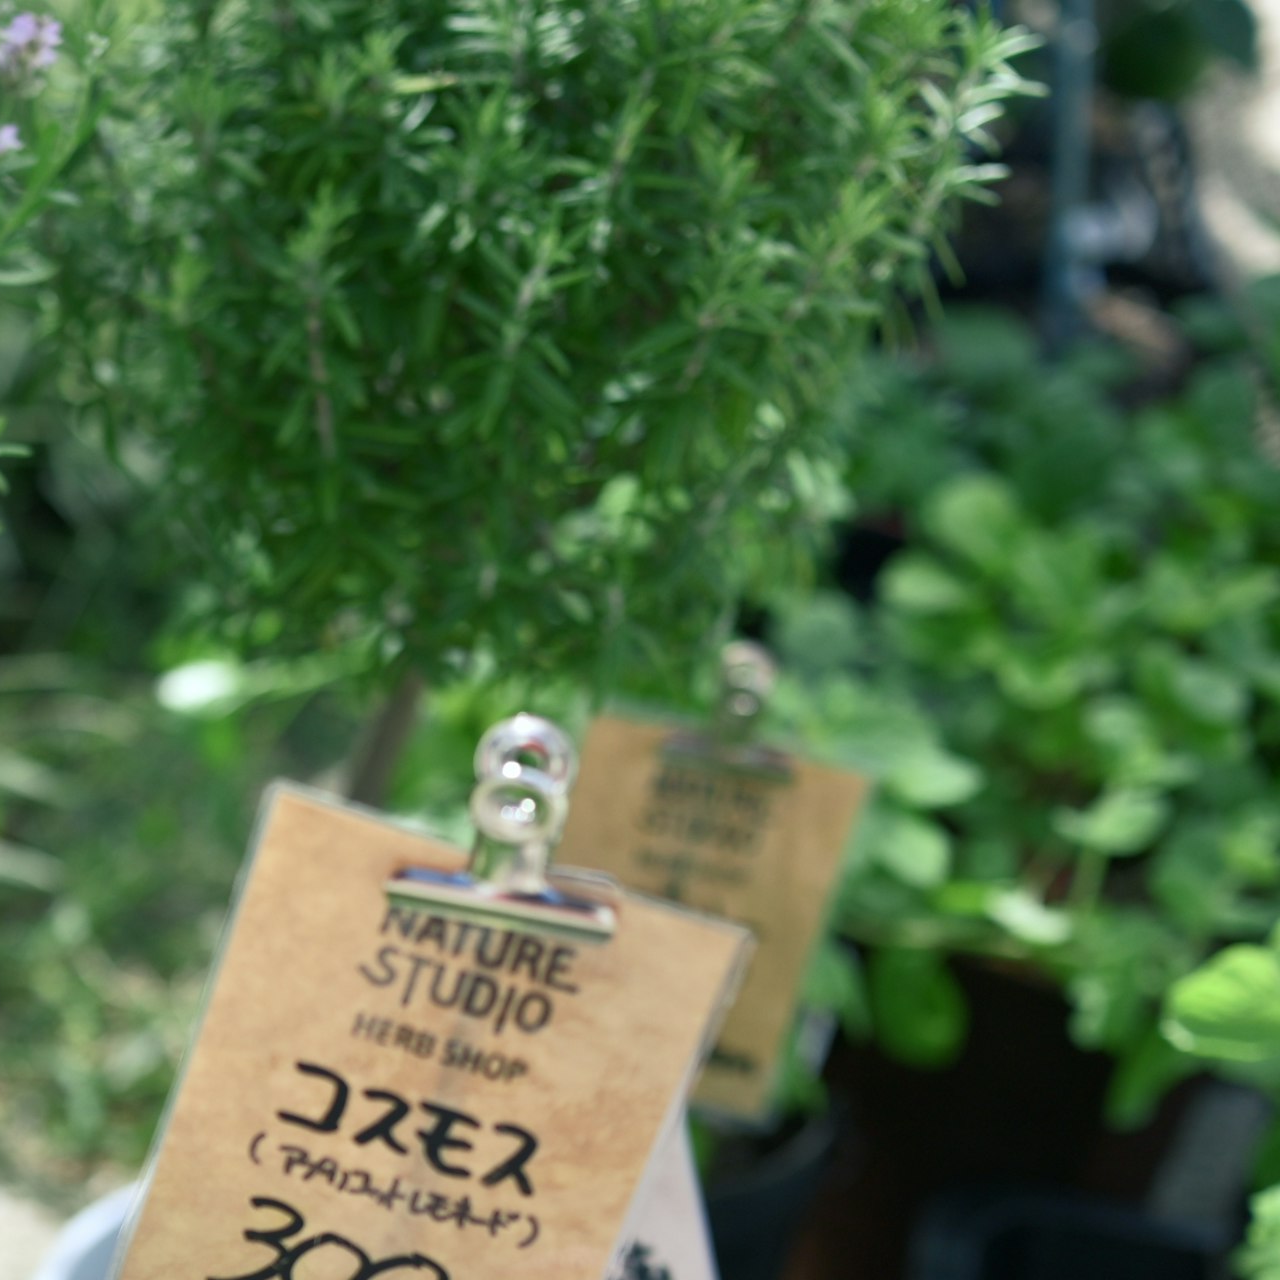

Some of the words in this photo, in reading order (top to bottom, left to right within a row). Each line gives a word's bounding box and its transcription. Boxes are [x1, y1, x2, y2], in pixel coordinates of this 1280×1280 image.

[358, 945, 553, 1036] STUDIO
[380, 905, 581, 996] NATURE
[352, 1013, 436, 1064] HERB
[440, 1035, 529, 1084] SHOP
[276, 1061, 540, 1198] コスモス
